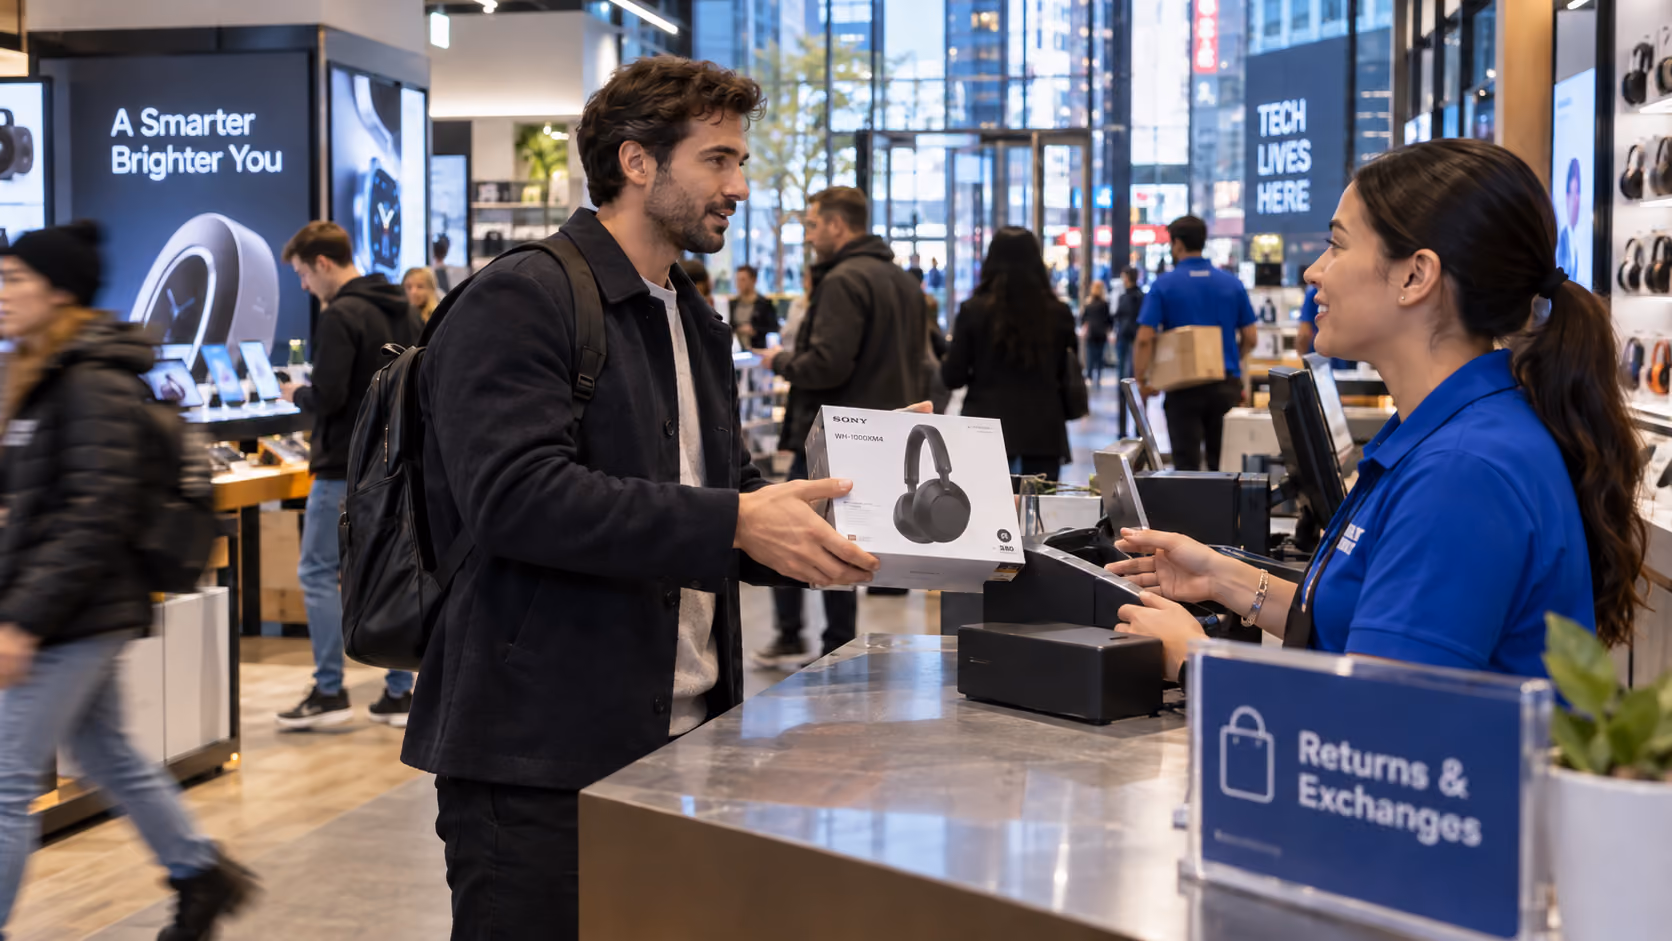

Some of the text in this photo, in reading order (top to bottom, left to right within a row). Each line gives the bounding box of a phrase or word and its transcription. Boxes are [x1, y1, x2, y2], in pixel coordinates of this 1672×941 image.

[110, 107, 256, 137] A Smarter
[1257, 98, 1307, 137] TECH
[111, 144, 283, 181] Brighter You
[1257, 138, 1312, 176] LIVES
[1257, 179, 1311, 214] HERE
[832, 415, 868, 424] SONY
[834, 432, 884, 442] WH-1000XM4
[1298, 729, 1470, 799] Returns &
[1298, 773, 1482, 846] Exchanges
